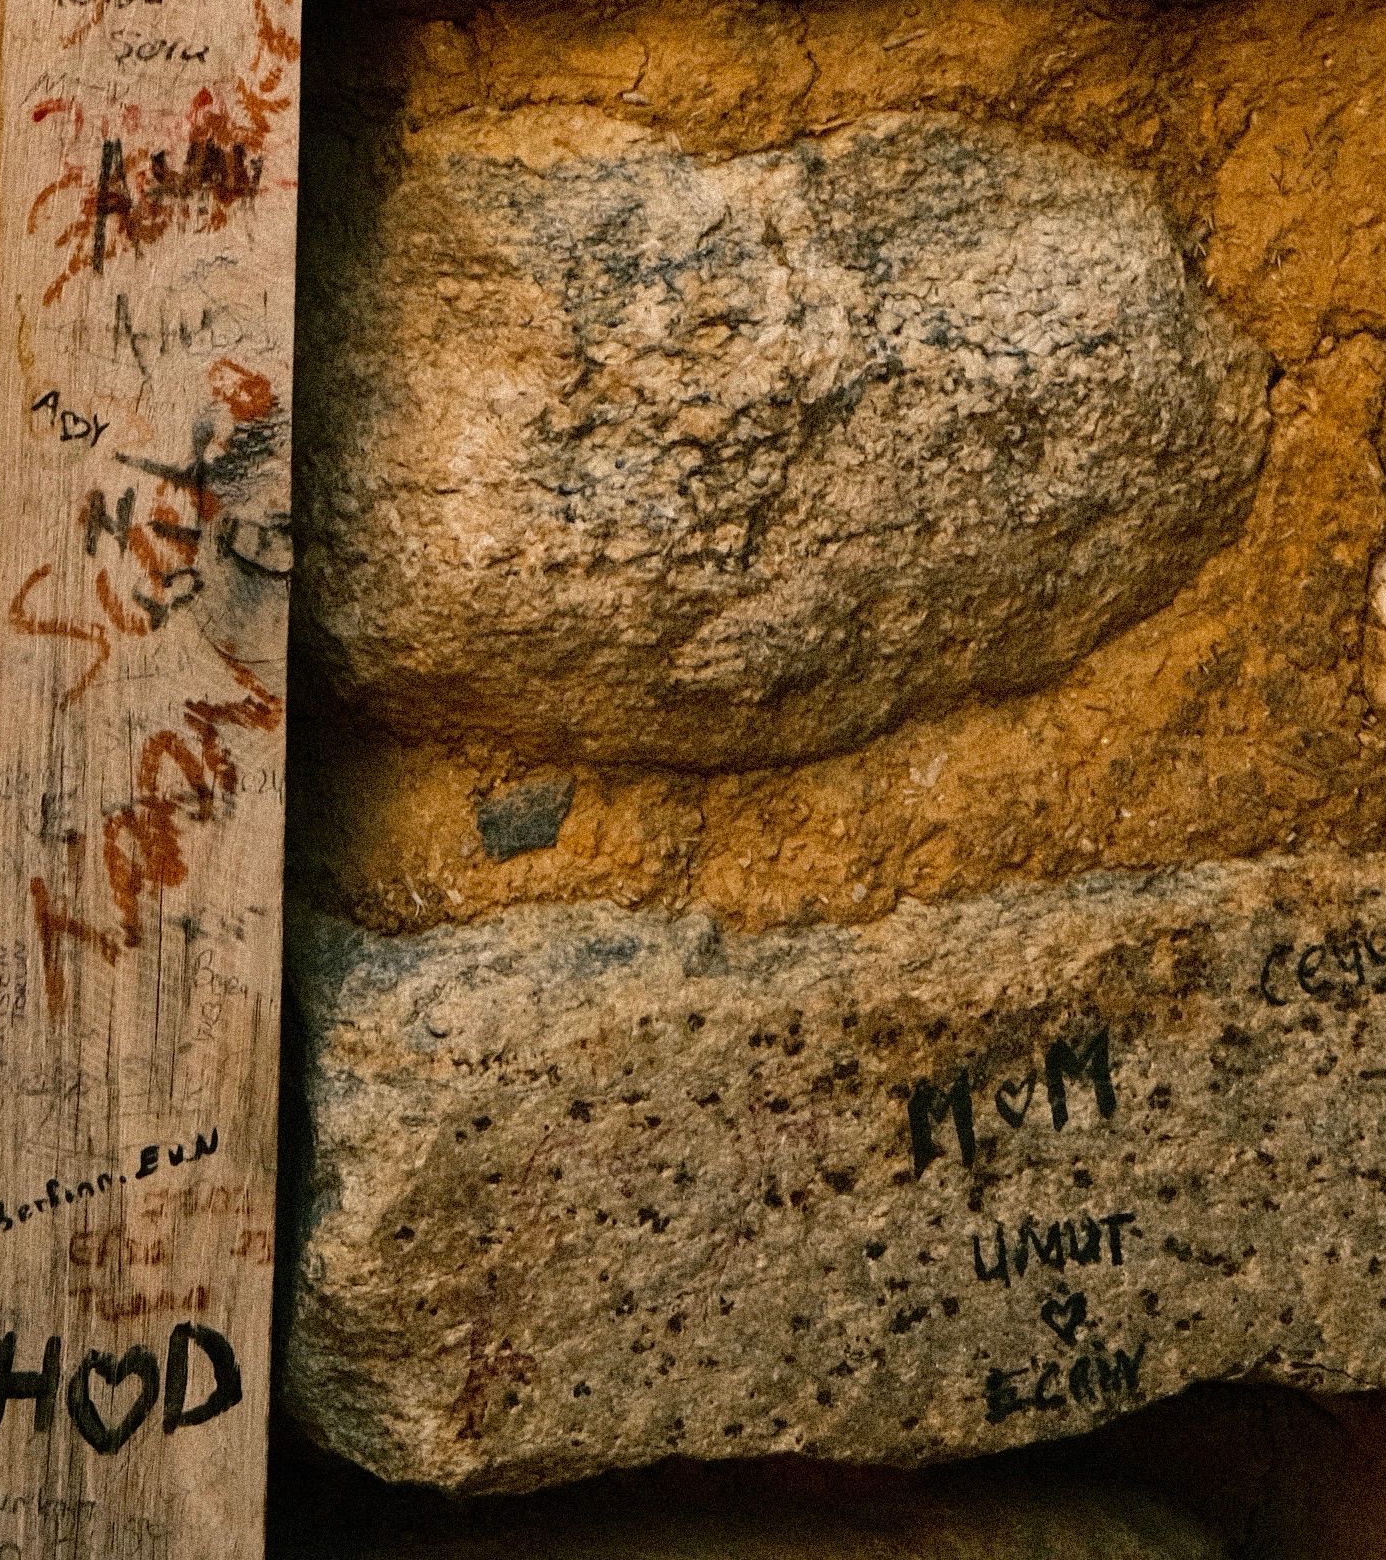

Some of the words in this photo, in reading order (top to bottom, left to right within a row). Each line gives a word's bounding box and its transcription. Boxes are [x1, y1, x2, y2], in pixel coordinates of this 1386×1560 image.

[907, 1068, 977, 1181] M
[1045, 1030, 1116, 1132] M
[163, 1318, 243, 1436] D
